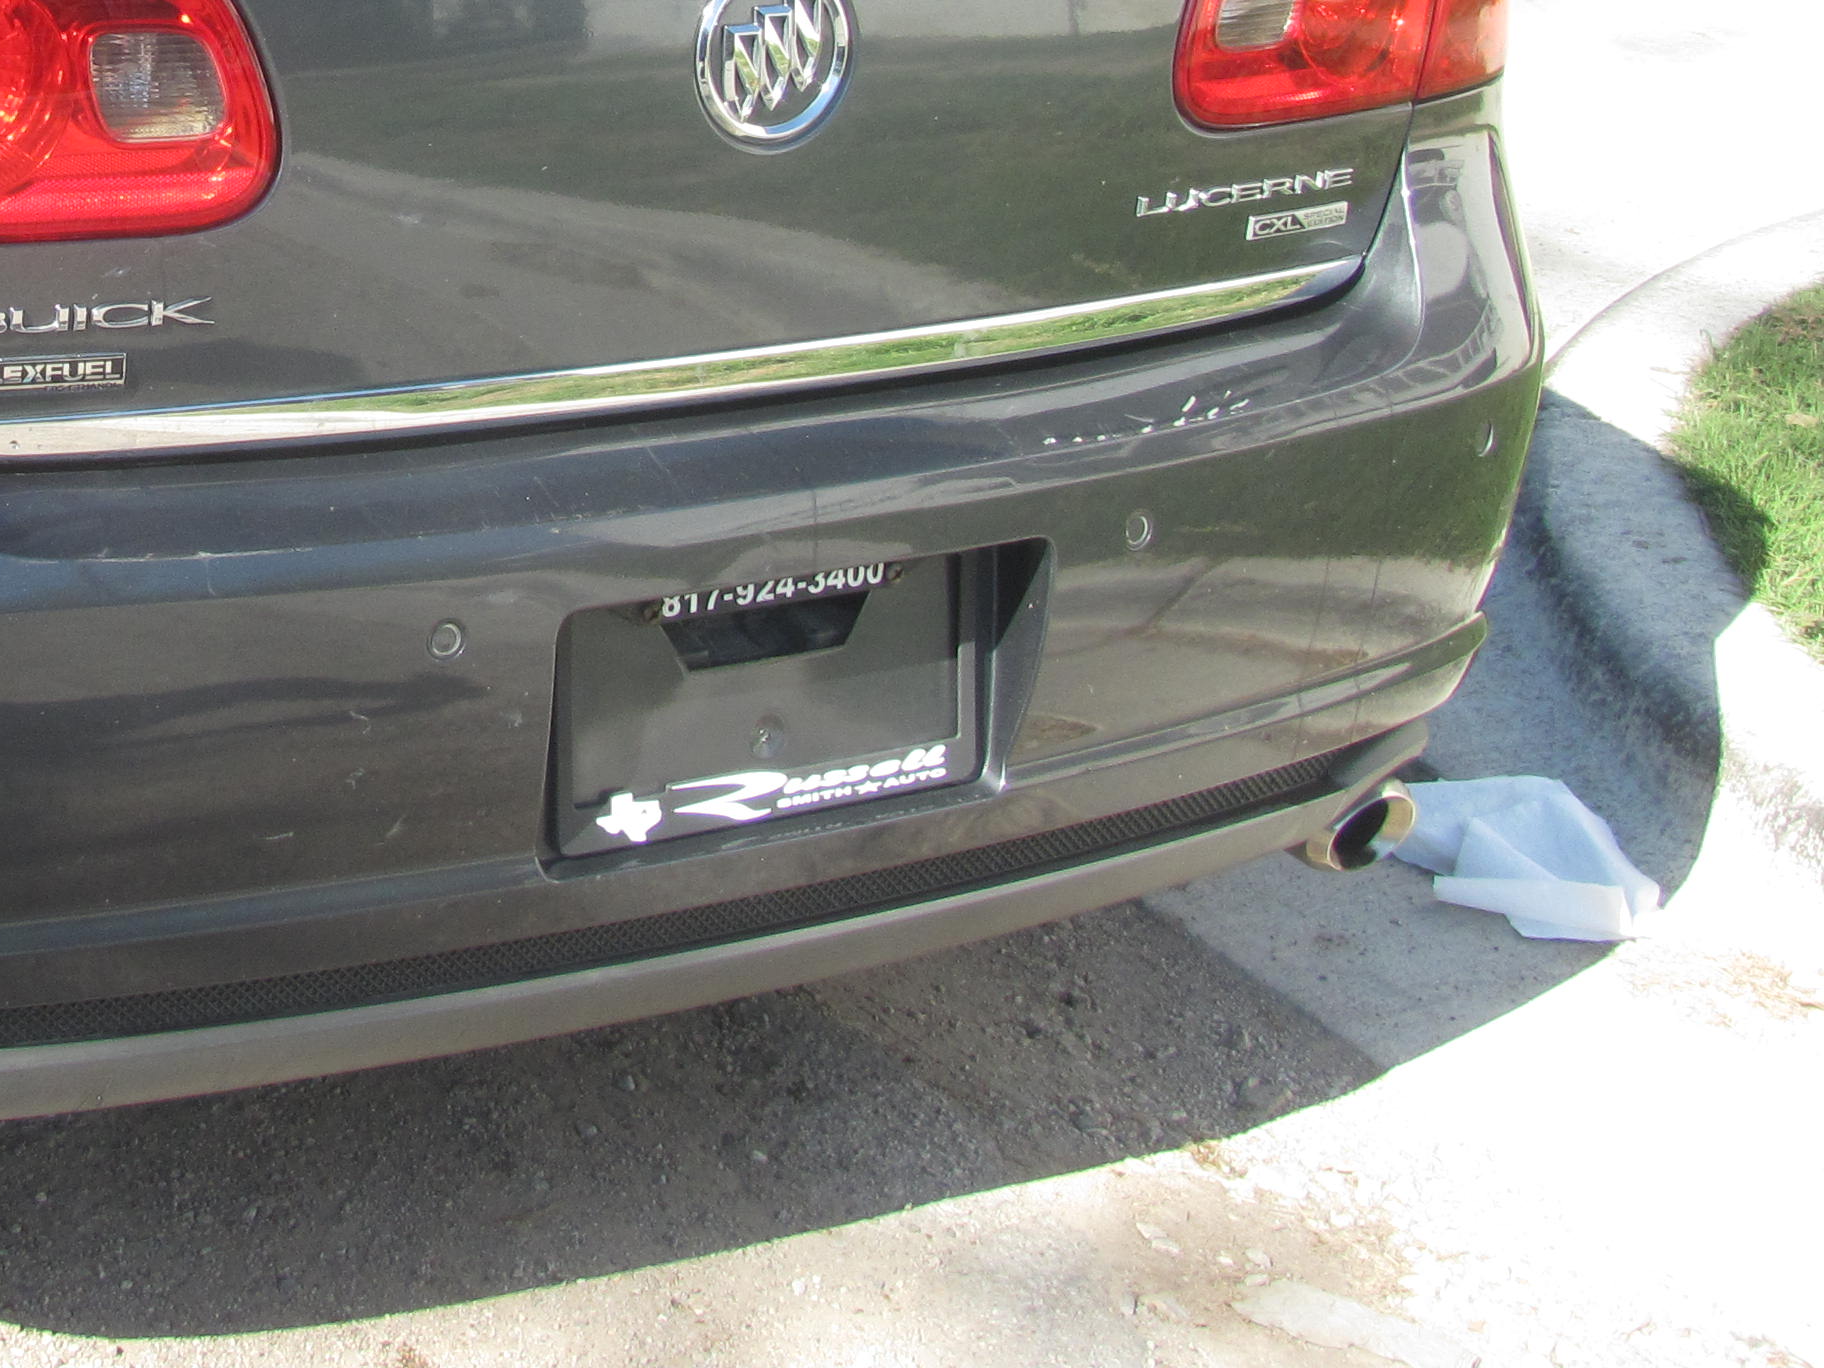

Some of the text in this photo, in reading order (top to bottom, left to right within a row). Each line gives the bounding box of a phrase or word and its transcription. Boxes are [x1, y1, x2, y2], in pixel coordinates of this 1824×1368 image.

[1136, 168, 1354, 217] LUCERNE
[1254, 214, 1302, 236] CXL
[662, 562, 886, 618] 817-924-3400
[776, 767, 947, 809] SMITH AUTO
